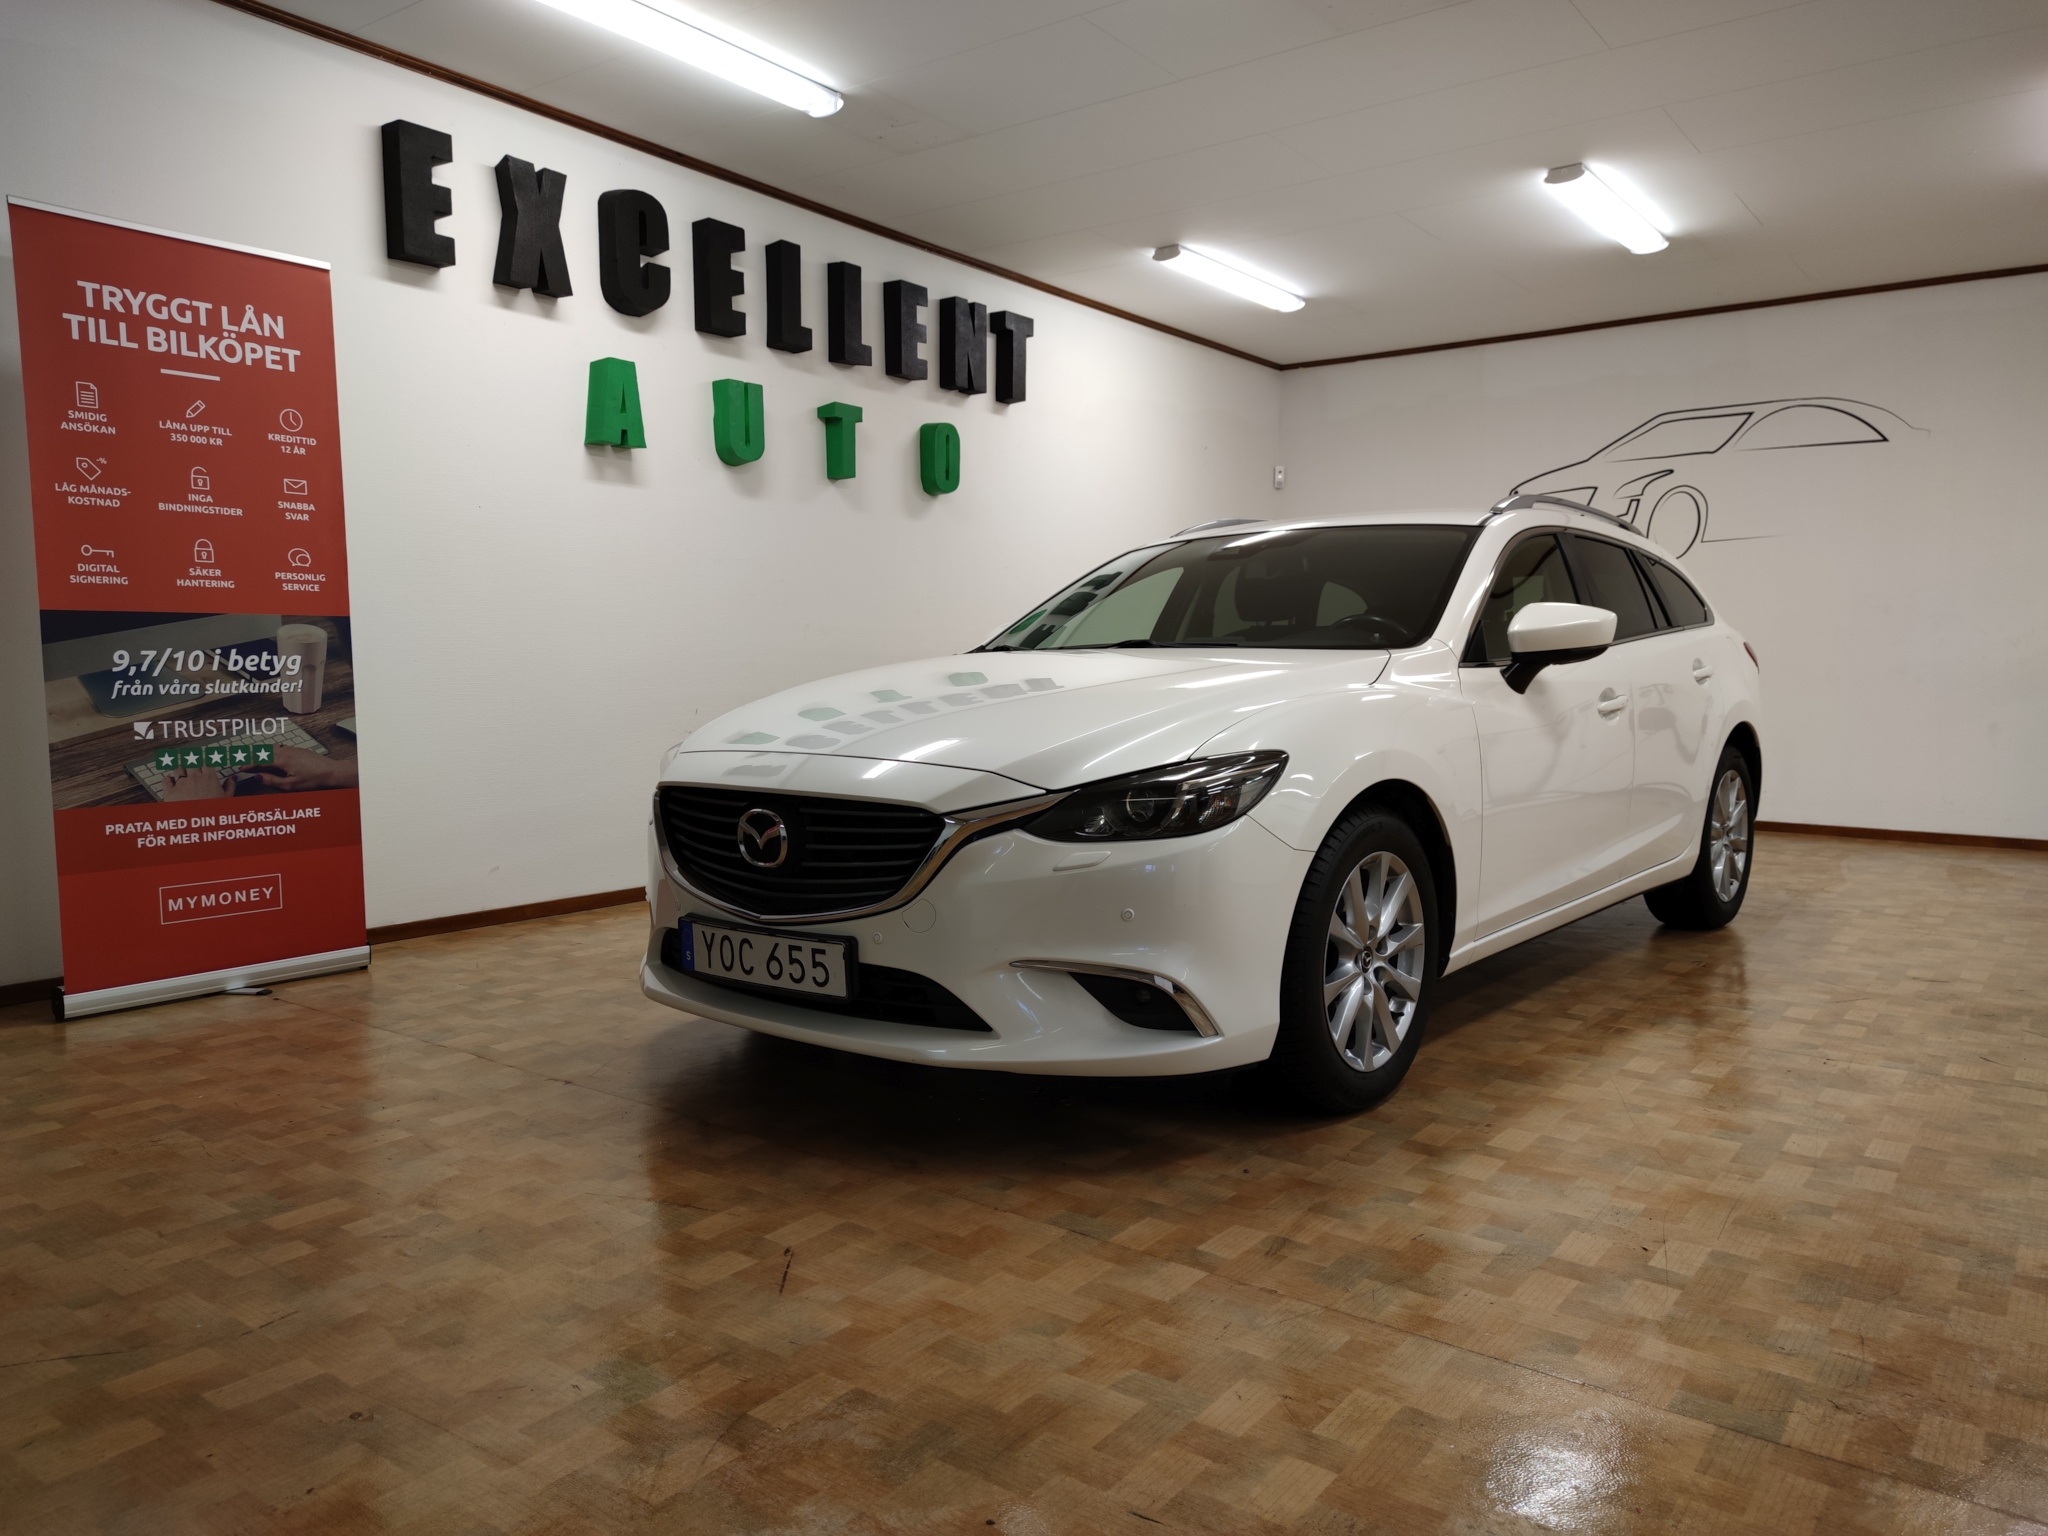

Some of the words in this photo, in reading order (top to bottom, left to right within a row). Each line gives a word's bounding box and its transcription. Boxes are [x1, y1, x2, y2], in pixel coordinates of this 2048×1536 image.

[381, 119, 1034, 404] EXCELLENT
[77, 280, 212, 326] TRYGGT
[221, 304, 284, 339] LÅN
[62, 312, 138, 349] TILL
[147, 325, 301, 373] BILKÖPET
[68, 410, 107, 422] SMIDIG
[60, 422, 116, 435] ANSÖKAN
[159, 420, 187, 433] LÅNA
[190, 424, 210, 433] UPP
[212, 426, 232, 436] TILL
[584, 356, 960, 496] AUTO
[170, 433, 188, 443] 350
[190, 435, 207, 444] 000
[209, 437, 223, 446] KR
[268, 433, 316, 446] KREDITTID
[281, 446, 291, 454] 12
[293, 445, 306, 455] ÅR
[55, 482, 77, 492] LÅG
[79, 483, 131, 496] MÅNADS-
[67, 495, 120, 507] KOSTNAD
[188, 493, 213, 503] INGA
[158, 503, 243, 516] BINDNINGSTIDER
[277, 501, 315, 511] SNABBA
[285, 512, 309, 521] SVAR
[77, 563, 120, 573] DIGITAL
[189, 566, 221, 577] SÄKER
[69, 575, 128, 585] SIGNERING
[176, 578, 235, 589] HANTERING
[275, 572, 325, 582] PERSONLIG
[282, 582, 320, 592] SERVICE
[111, 648, 204, 677] 9,7/10
[212, 649, 221, 671] i
[227, 649, 301, 675] betyg
[111, 680, 153, 699] från
[159, 679, 200, 695] våra
[205, 679, 303, 694] slutkunder!
[158, 717, 289, 738] TRUSTPILOT
[105, 821, 153, 835] PRATA
[156, 818, 188, 832] MED
[191, 816, 215, 829] DIN
[219, 807, 321, 827] BILFÖRSÄLJARE
[137, 834, 166, 849] FÖR
[170, 833, 200, 845] MER
[203, 824, 296, 843] INFORMATION
[168, 886, 274, 912] MYMONEY
[686, 951, 691, 961] S
[701, 930, 755, 975] YOC
[766, 943, 830, 988] 655
